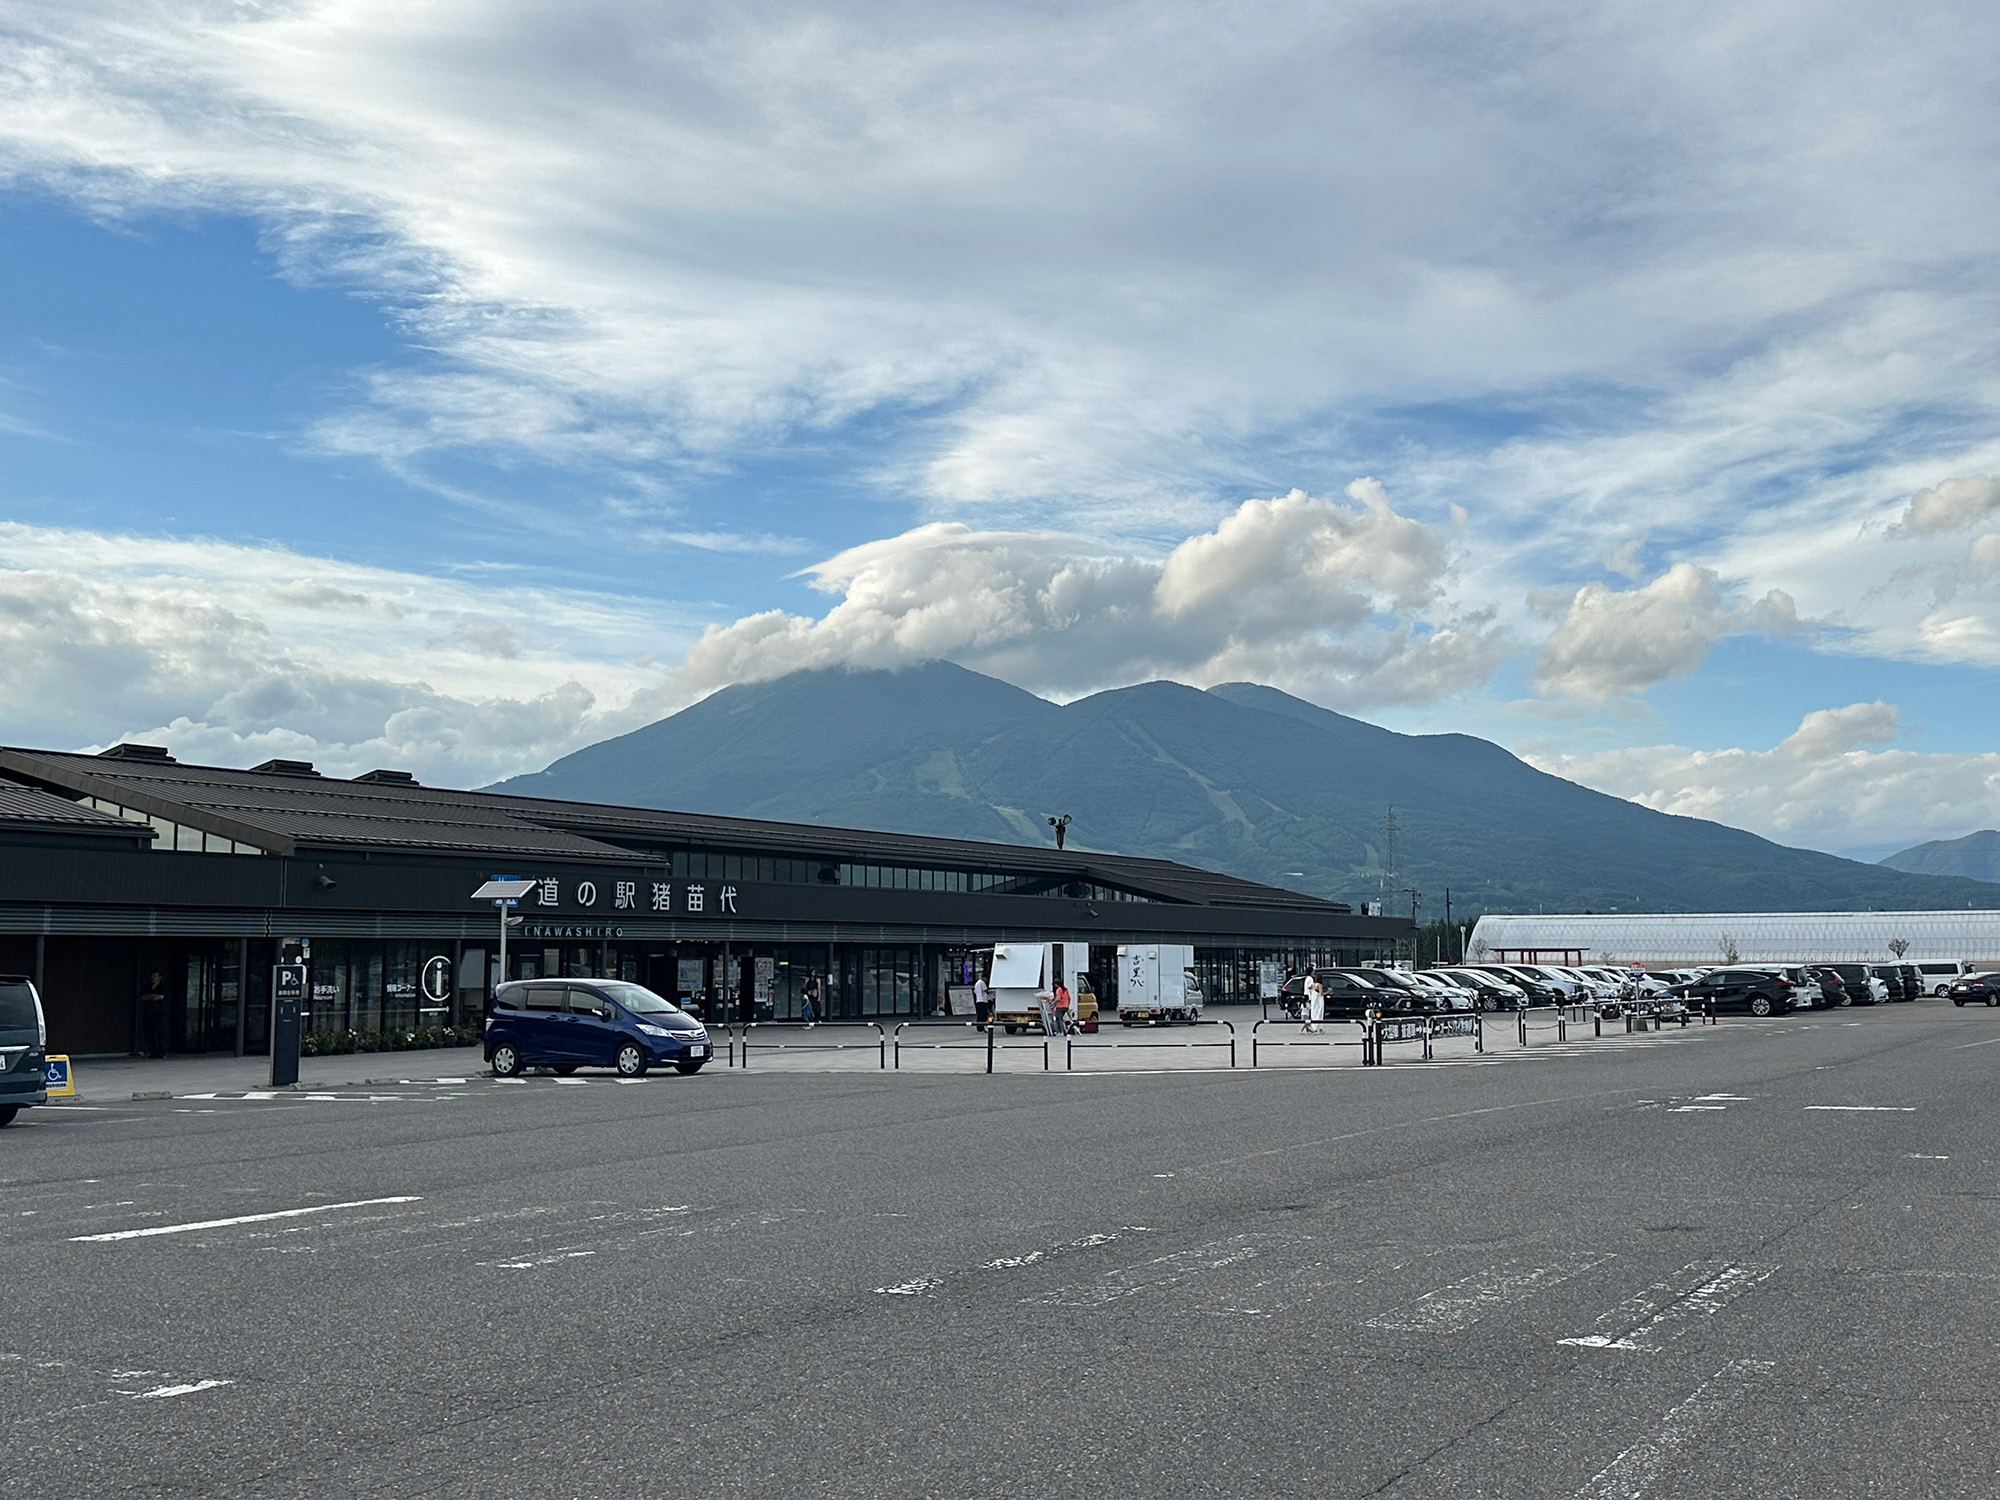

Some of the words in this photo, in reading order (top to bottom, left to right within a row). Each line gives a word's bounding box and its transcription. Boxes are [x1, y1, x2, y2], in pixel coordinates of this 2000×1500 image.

[538, 877, 737, 913] 道の駅猪苗代
[525, 926, 623, 937] INAWASHIRO
[282, 971, 292, 985] P
